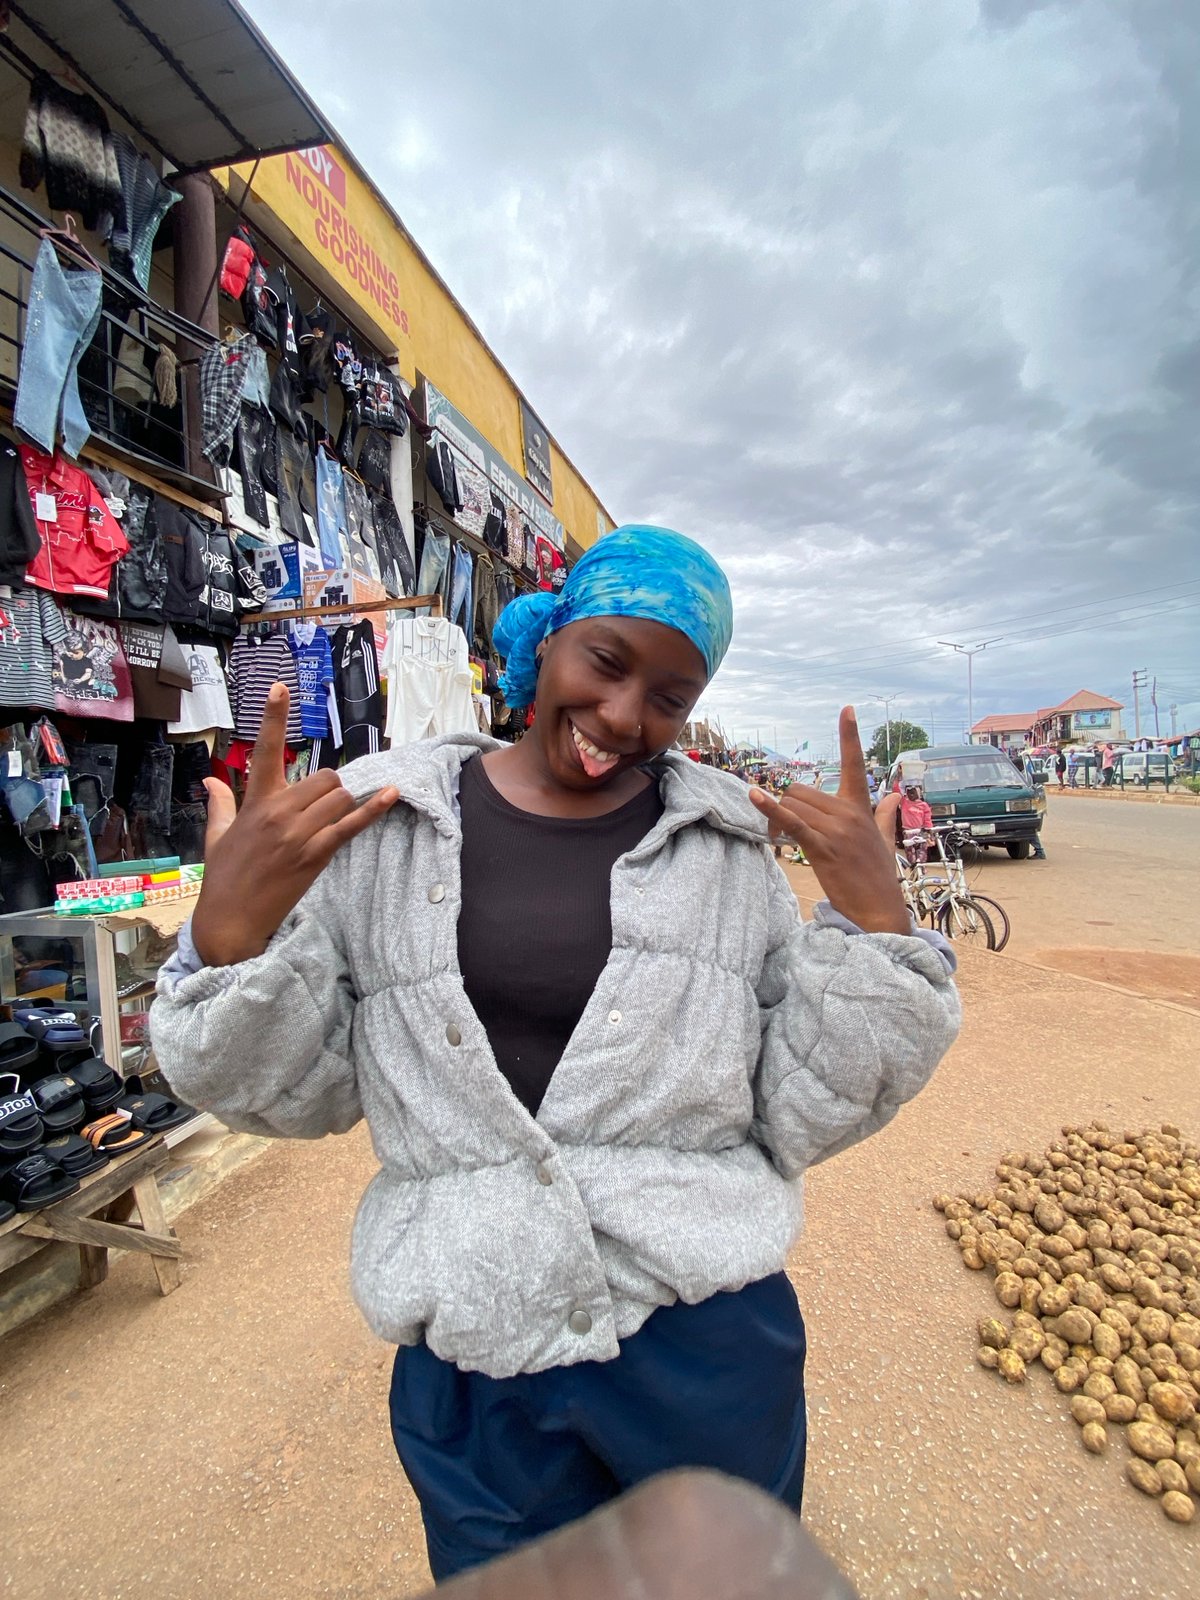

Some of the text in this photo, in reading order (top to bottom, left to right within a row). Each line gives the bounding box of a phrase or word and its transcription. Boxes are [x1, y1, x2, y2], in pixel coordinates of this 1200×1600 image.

[285, 153, 400, 300] NOURISHING
[314, 216, 409, 335] GOODNESS
[130, 627, 163, 641] ESTERDAY
[151, 650, 161, 659] BE
